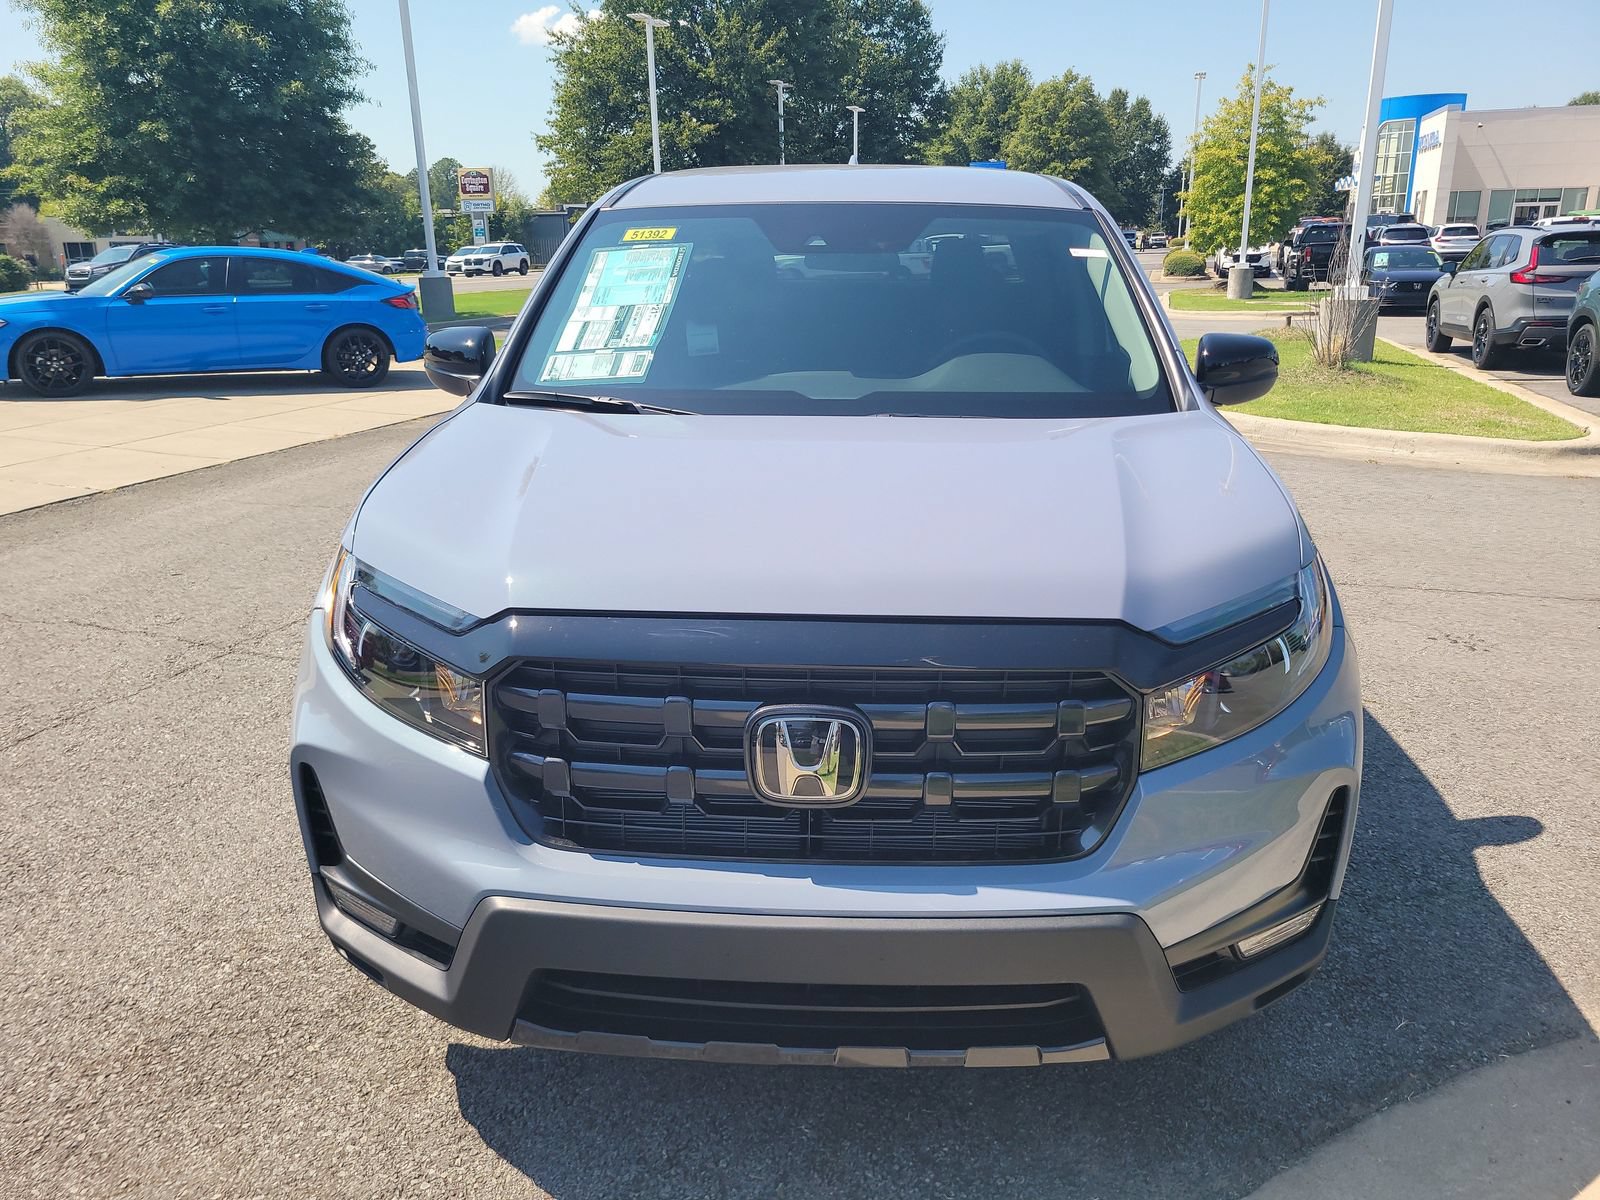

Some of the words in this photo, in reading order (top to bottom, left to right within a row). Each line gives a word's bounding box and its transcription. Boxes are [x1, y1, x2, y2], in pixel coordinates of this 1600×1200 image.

[466, 184, 484, 193] Square
[630, 229, 668, 240] 51392
[672, 253, 684, 277] HONDA
